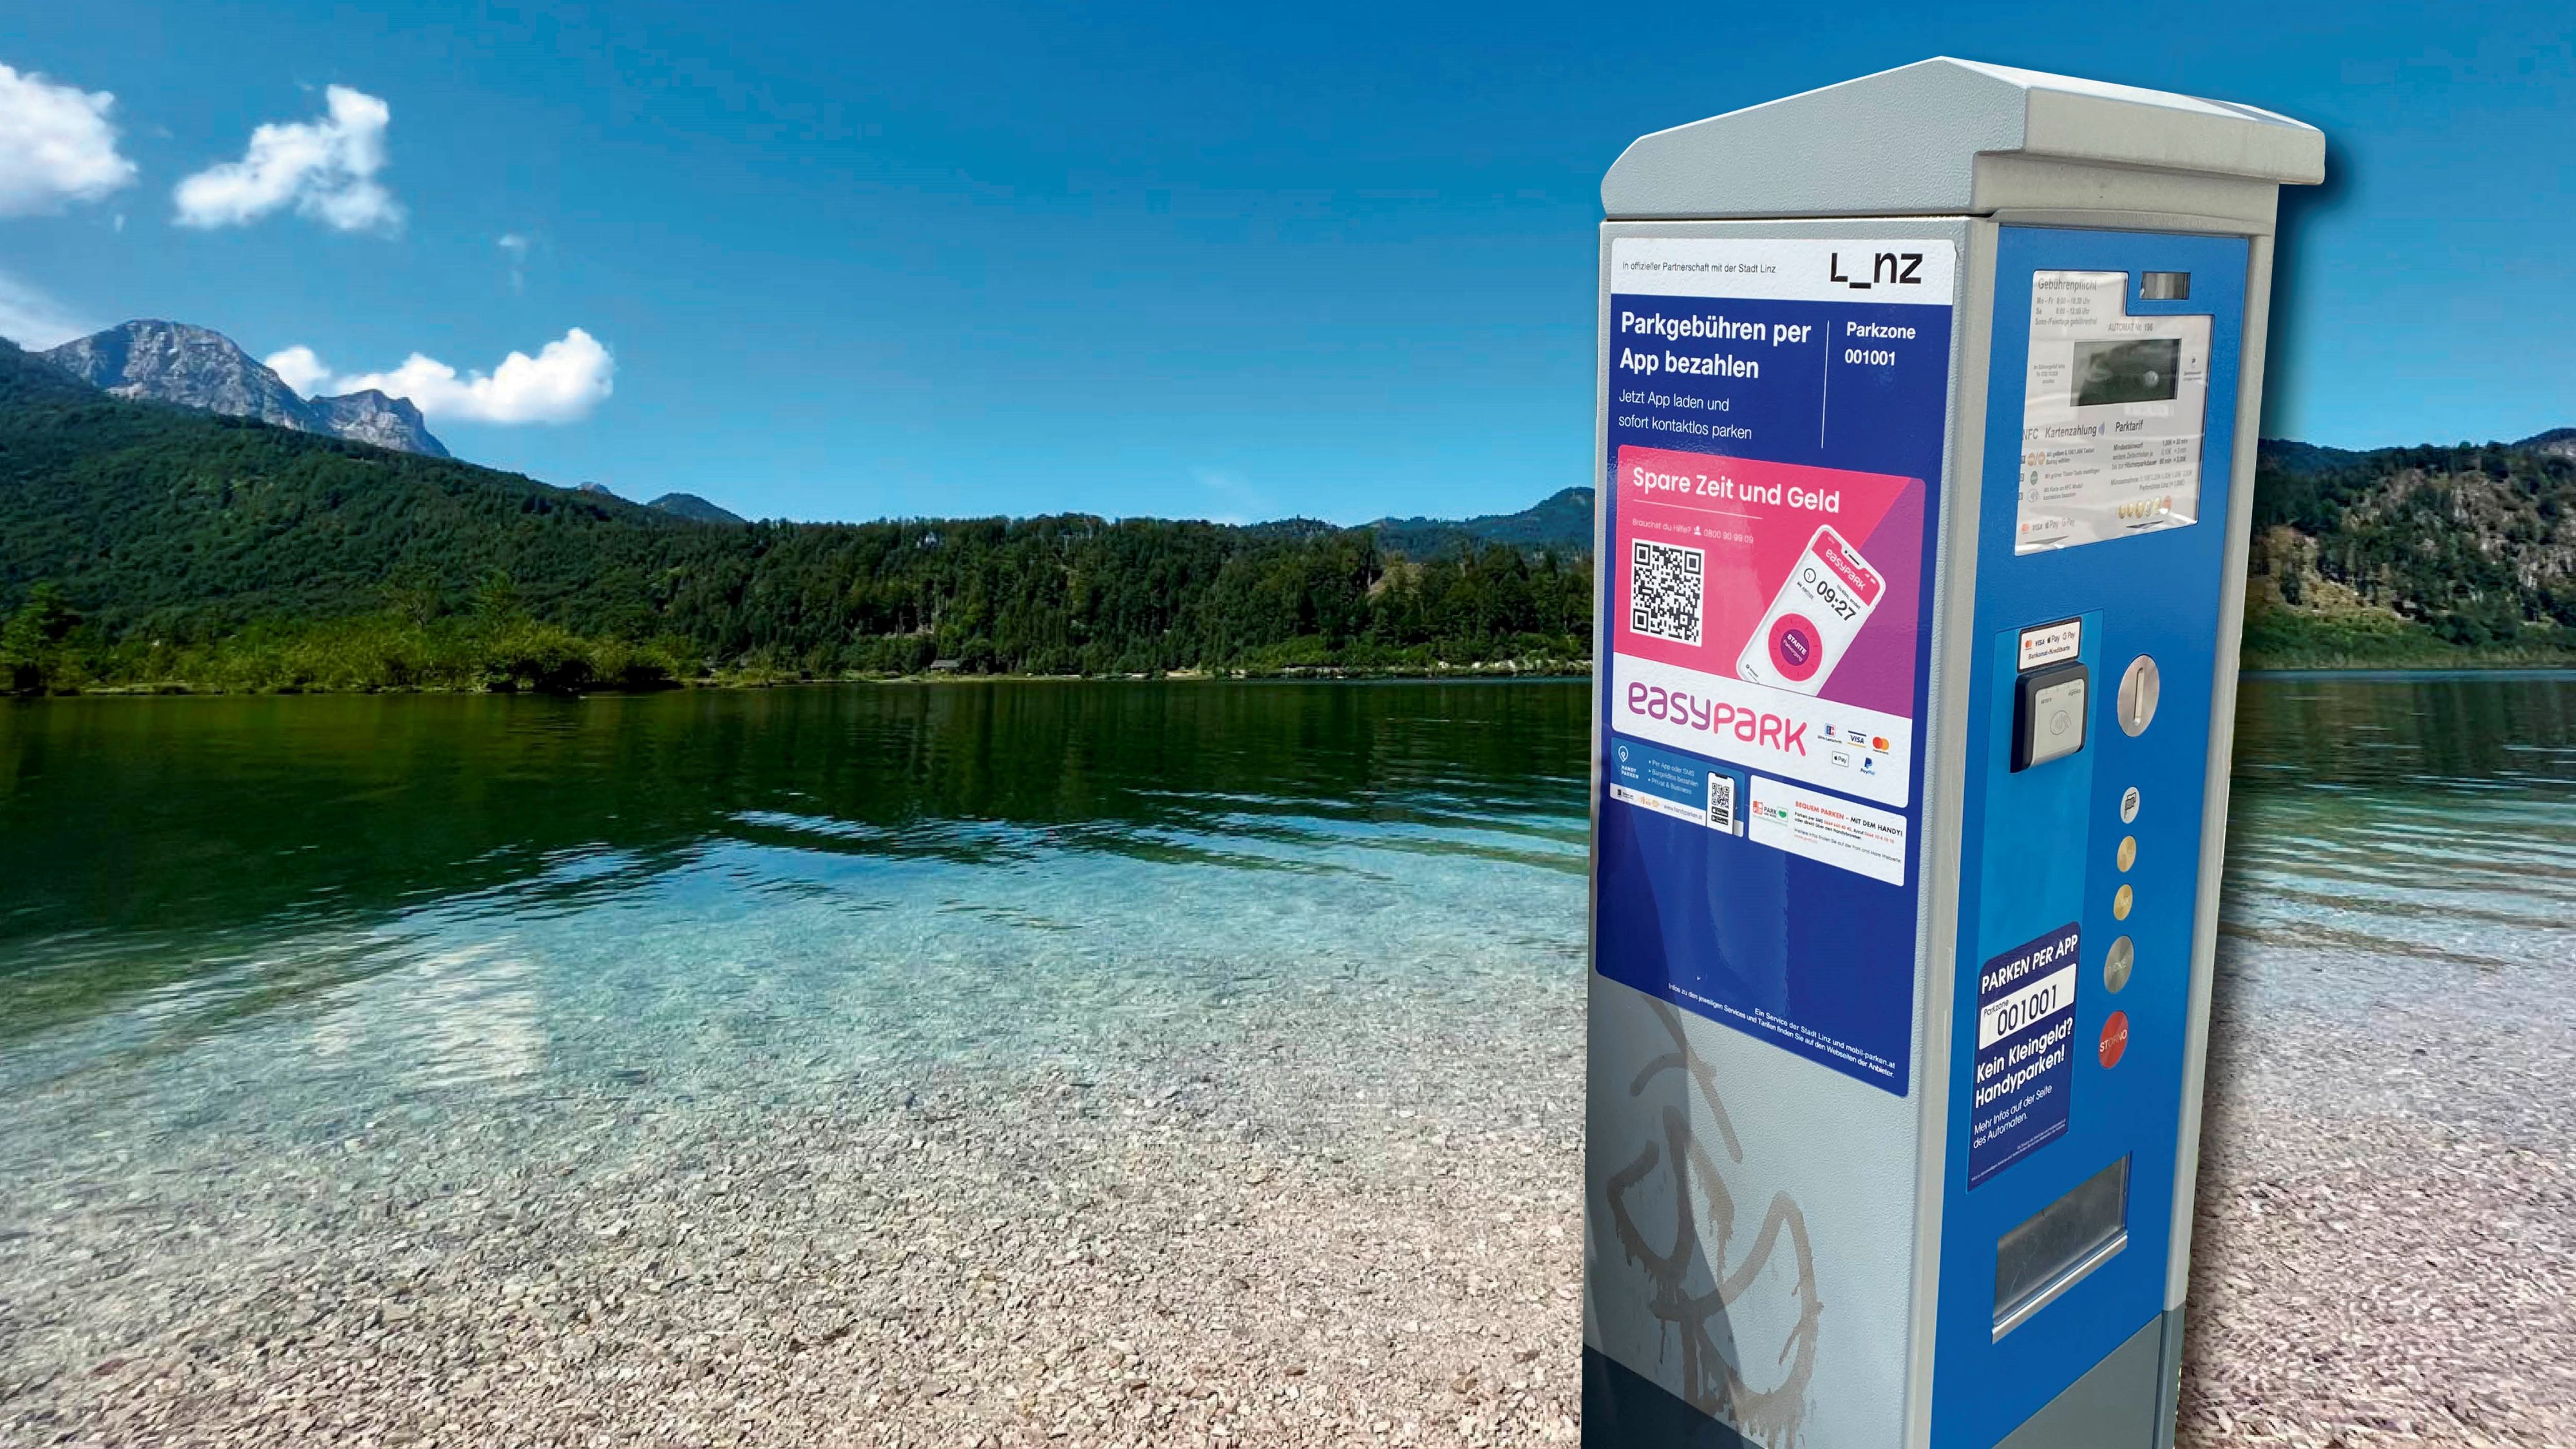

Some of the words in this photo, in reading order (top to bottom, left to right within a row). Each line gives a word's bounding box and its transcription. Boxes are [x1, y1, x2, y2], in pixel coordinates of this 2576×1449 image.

[1631, 262, 1660, 270] offizieller
[1662, 262, 1709, 271] Partnerschaft
[1725, 264, 1736, 272] der
[1738, 264, 1757, 273] Stadt
[1760, 264, 1776, 273] Linz
[1622, 312, 1766, 341] Parkgebühren
[1773, 322, 1812, 346] per
[1847, 322, 1916, 339] Parkzone
[1620, 348, 1660, 376] App
[1665, 354, 1759, 379] bezahlen
[1845, 348, 1895, 366] 001001
[1619, 390, 1645, 404] Jetzt
[1647, 391, 1671, 408] App
[1673, 394, 1704, 410] laden
[1707, 397, 1730, 412] und
[1618, 415, 1649, 430] sofort
[1652, 418, 1709, 435] kontaktlos
[1712, 424, 1752, 440] parken
[2045, 424, 2097, 438] Kartenzahlung
[2116, 419, 2143, 433] Parktarif
[1633, 467, 1691, 495] Spare
[1696, 475, 1734, 499] Zeit
[1739, 482, 1781, 506] und
[1787, 489, 1840, 513] Geld
[1633, 518, 1661, 529] Brauchst
[1663, 523, 1672, 531] du
[1674, 524, 1691, 534] Hilfe?
[1703, 529, 1721, 539] 0800
[1744, 535, 1754, 544] 09
[1817, 581, 1857, 621] 09:27
[1787, 634, 1808, 655] STARTE
[2035, 639, 2045, 647] VISA
[2051, 634, 2060, 643] Pay
[1850, 735, 1864, 744] VISA
[1621, 764, 1637, 773] HANDY
[1621, 771, 1639, 779] PARKEN
[1661, 762, 1671, 771] App
[1671, 764, 1682, 773] oder
[1860, 768, 1876, 776] PayPal
[1677, 774, 1699, 787] bezahlen
[1764, 806, 1777, 815] PARK
[1795, 801, 1819, 813] BEQUEM
[1821, 808, 1844, 820] PARKEN
[1863, 820, 1876, 829] DEM
[1878, 824, 1903, 837] HANDY!
[1981, 956, 2029, 995] PARKEN
[2032, 947, 2053, 971] PER
[2056, 934, 2078, 959] APP
[1984, 999, 2009, 1018] Parkzone
[1997, 984, 2058, 1036] 001001
[1669, 983, 1681, 994] Infos
[1689, 990, 1698, 1000] den
[1698, 994, 1723, 1011] jeweiligen
[1724, 1005, 1746, 1020] Services
[1747, 1013, 1757, 1023] und
[1757, 1017, 1776, 1032] Tarifen
[1777, 1025, 1794, 1038] finden
[1795, 1032, 1804, 1043] Sie
[1804, 1037, 1814, 1046] auf
[1814, 1040, 1826, 1052] den
[1826, 1045, 1857, 1064] Webseiten
[1857, 1057, 1868, 1068] der
[1868, 1062, 1895, 1079] Anbieter.
[1755, 1007, 1765, 1018] Ein
[1766, 1011, 1788, 1027] Service
[1789, 1021, 1800, 1032] der
[1801, 1026, 1817, 1039] Stadt
[1818, 1032, 1832, 1044] Linz
[1833, 1038, 1844, 1050] und
[1846, 1043, 1896, 1070] mobil-parken.at
[1976, 1056, 2005, 1084] Kein
[2008, 1017, 2073, 1064] Kleingeld?
[1975, 1044, 2065, 1109] Handyparken!
[1974, 1117, 1993, 1135] Mehr
[1993, 1108, 2010, 1124] Infos
[2010, 1100, 2022, 1115] auf
[2023, 1092, 2036, 1108] der
[2036, 1084, 2053, 1101] Seite
[1973, 1134, 1987, 1150] des
[1987, 1112, 2028, 1142] Automaten.
